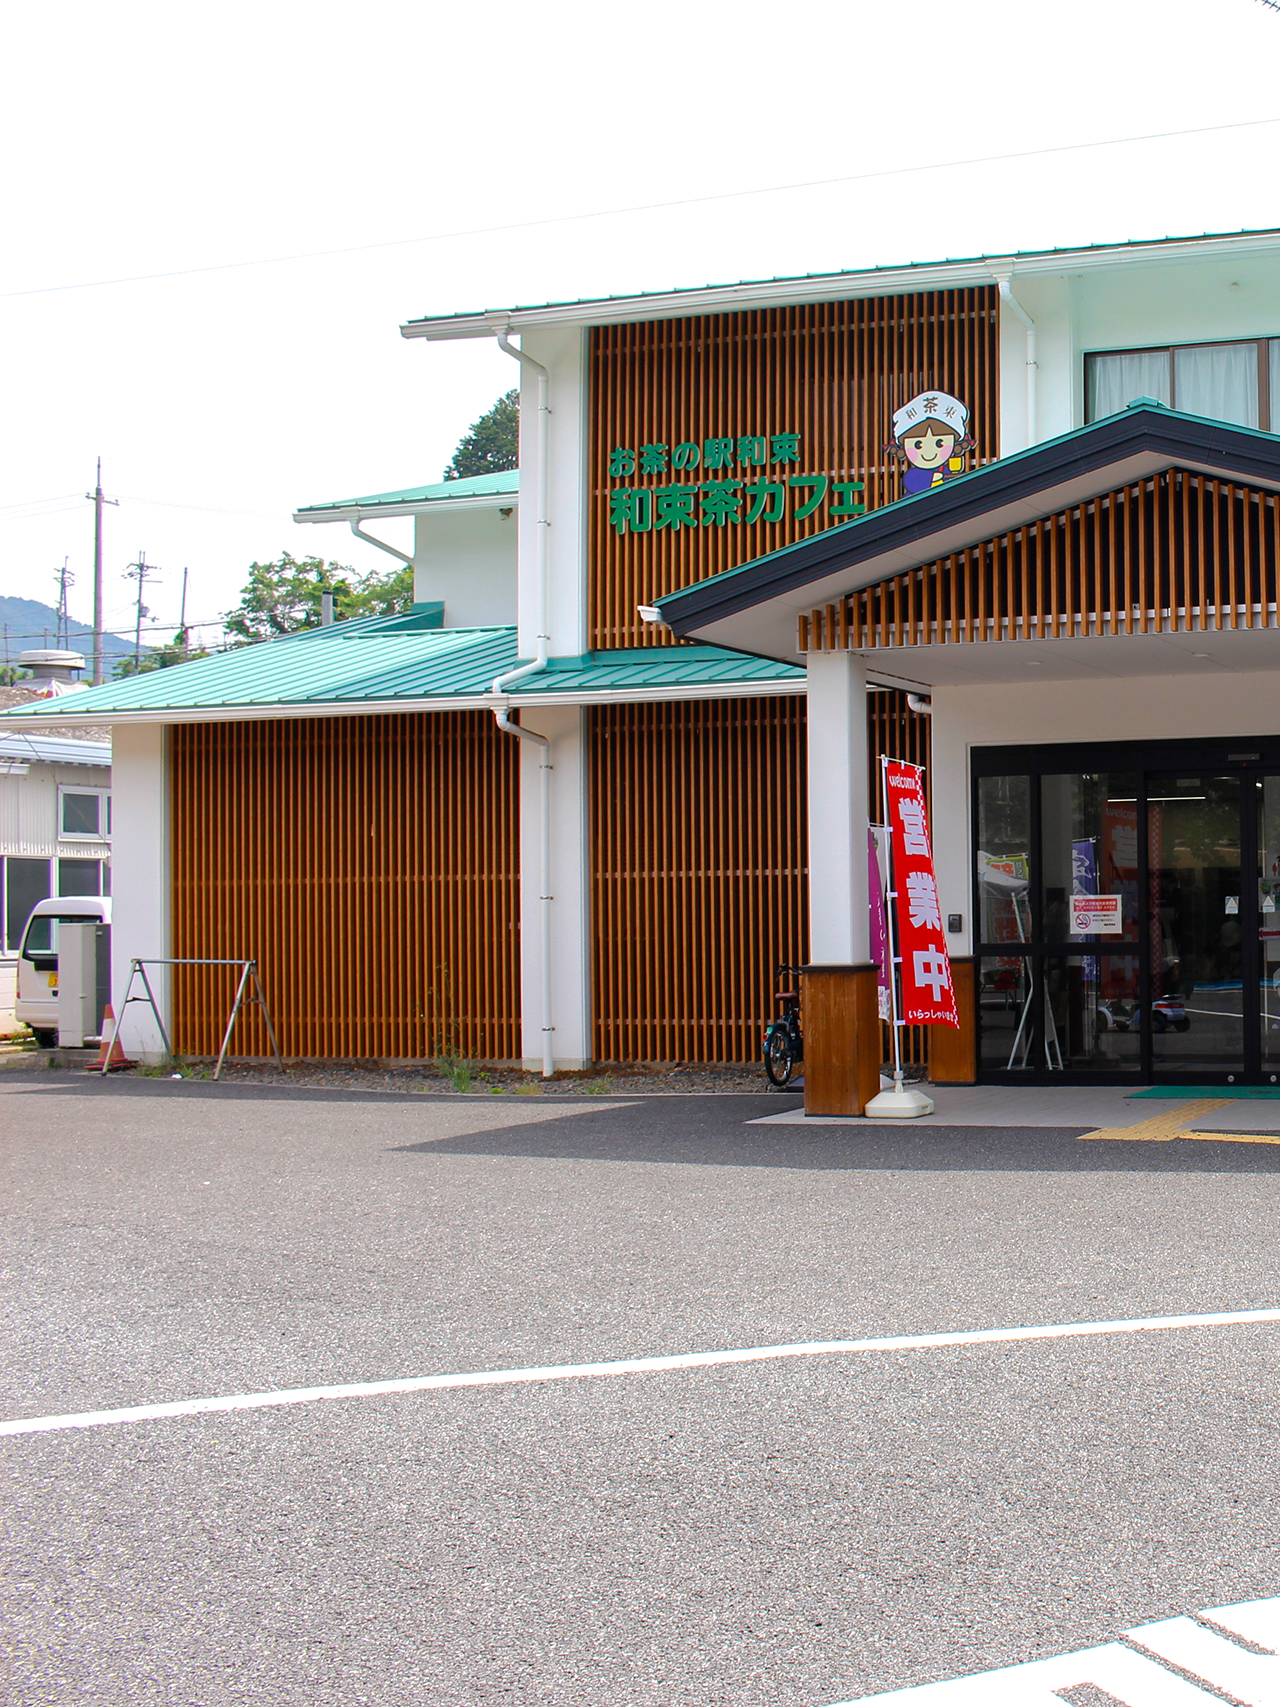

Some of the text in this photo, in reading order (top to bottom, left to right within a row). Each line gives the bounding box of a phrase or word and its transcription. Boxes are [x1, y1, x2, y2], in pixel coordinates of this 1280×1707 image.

[608, 432, 801, 478] お茶の駅和束
[608, 475, 867, 535] 和束茶カフェ
[899, 797, 950, 1002] 営業中
